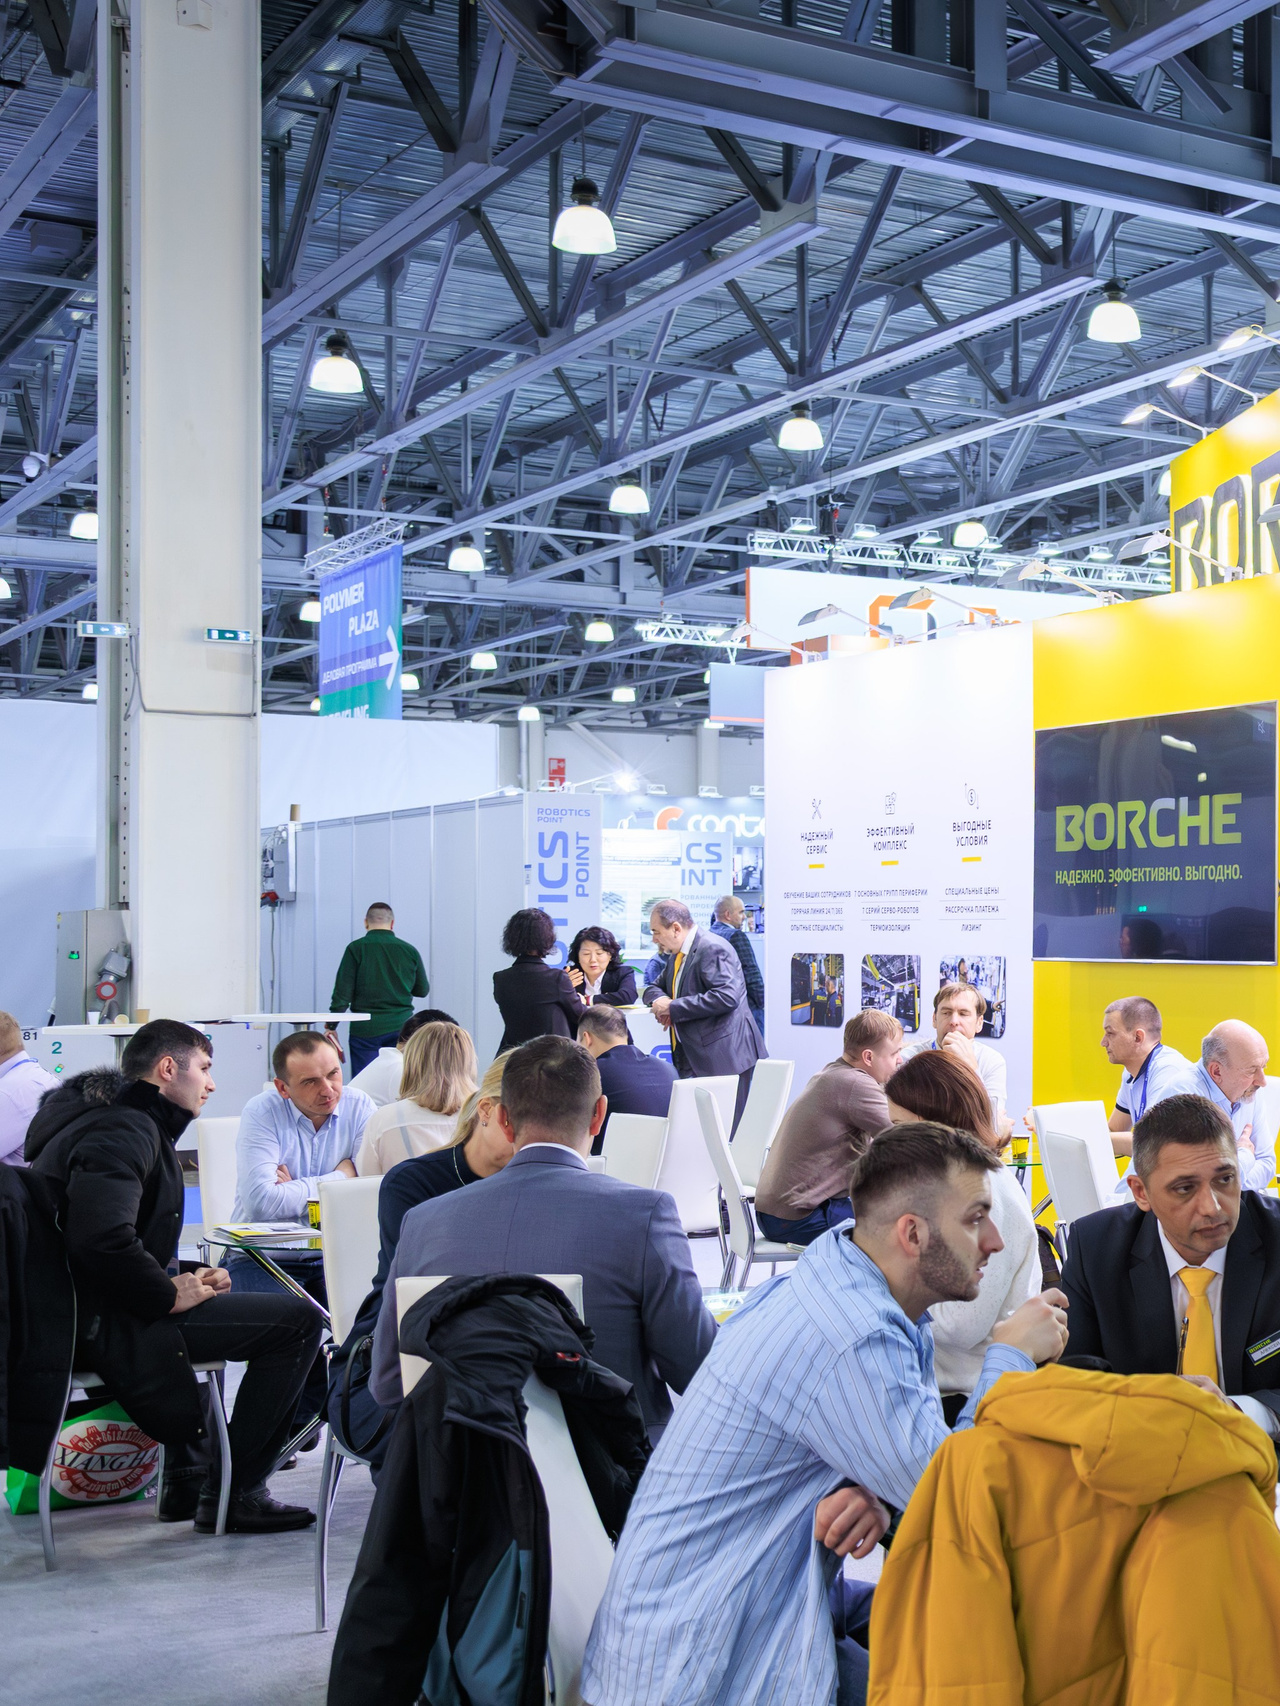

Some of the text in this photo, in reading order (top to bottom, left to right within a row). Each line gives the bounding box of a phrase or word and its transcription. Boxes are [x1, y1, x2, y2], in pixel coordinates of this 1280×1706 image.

[323, 581, 365, 617] POLYMER
[348, 608, 380, 638] PLAZA
[537, 807, 591, 817] ROBOTICS
[688, 813, 765, 838] cont
[952, 819, 992, 835] ВЫГОДНЫЕ
[1055, 792, 1242, 852] BORCHE
[800, 828, 834, 843] НАДЕЖНЫЙ
[866, 823, 915, 838] ЭФФЕКТИВНЫЙ
[873, 840, 908, 851] КОМПЛЕКС
[956, 835, 989, 847] УСЛОВИЯ
[806, 844, 828, 855] СЕРВИС
[575, 832, 590, 898] POINT
[1055, 864, 1243, 886] НАДЕЖНО. ЭФФЕКТИВНО. ВЫГОДНО.
[857, 890, 883, 898] ОСНОВНЫХ
[883, 889, 899, 897] ГРУПП
[899, 888, 928, 896] ПЕРИФЕРИИ
[945, 886, 1000, 897] СПЕЦИАЛЬНЫЕ ЦЕНЫ
[865, 905, 881, 914] СЕРИЙ
[881, 906, 919, 915] СЕРВО-РОБОТОВ
[945, 905, 1000, 914] РАССРОЧКА ПЛАТЕЖА
[870, 924, 911, 933] ТЕРМОИЗОЛЯЦИЯ
[961, 924, 982, 932] ЛИЗИНГ
[51, 1041, 63, 1054] 2
